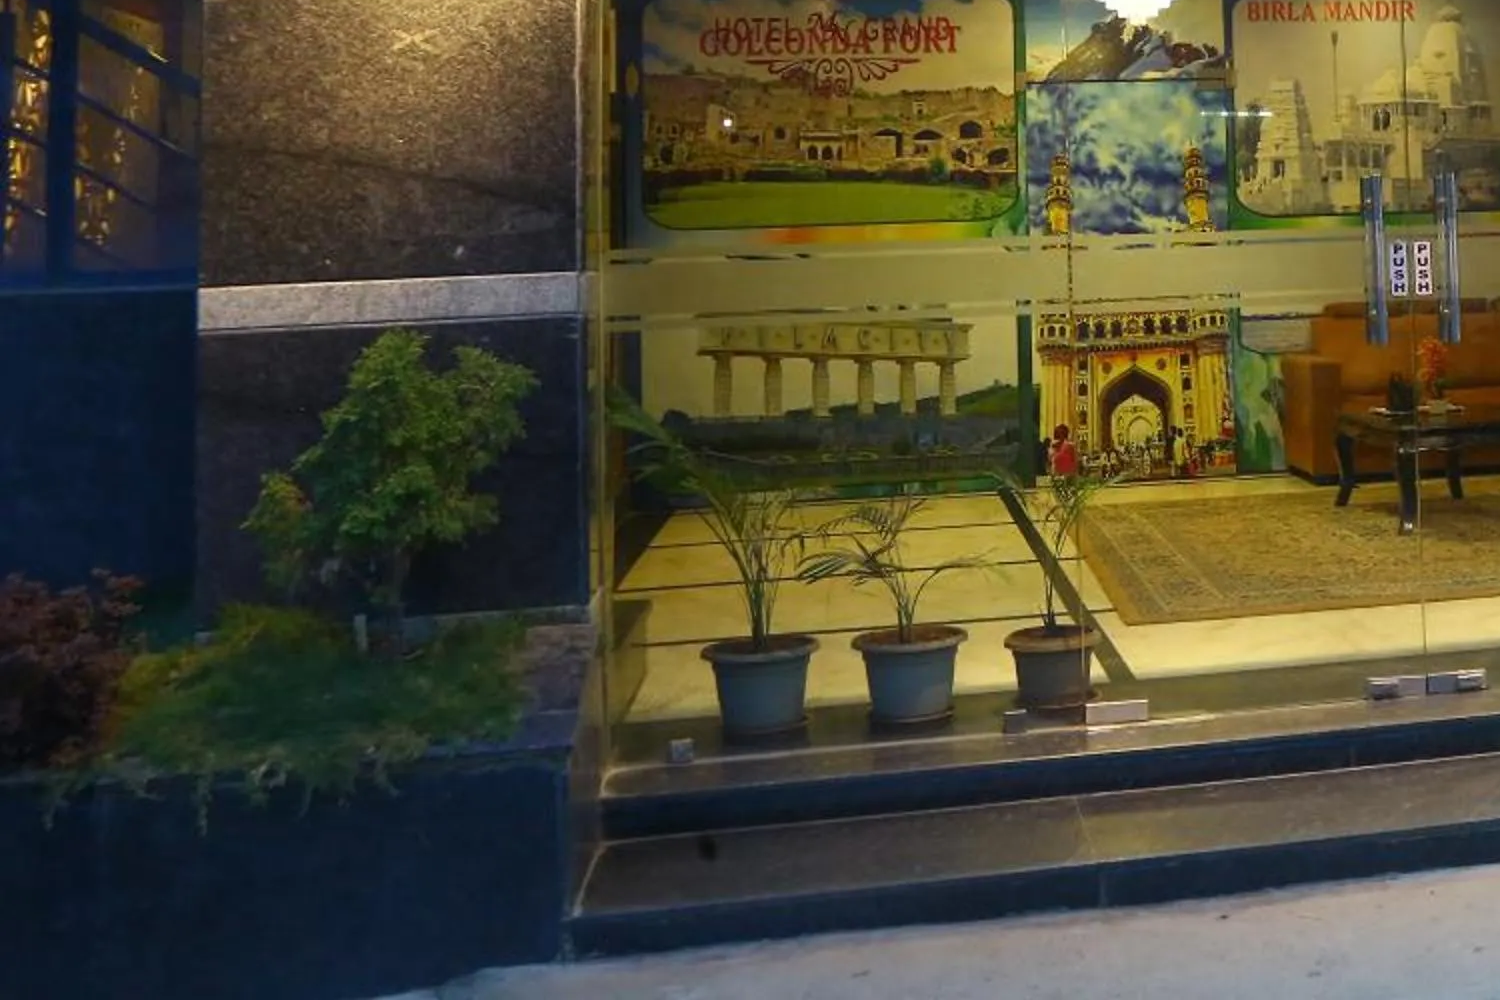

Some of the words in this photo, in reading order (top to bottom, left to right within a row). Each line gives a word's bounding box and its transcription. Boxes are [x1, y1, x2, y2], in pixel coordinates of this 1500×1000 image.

[1247, 0, 1317, 23] BIRLA
[1324, 0, 1416, 21] MANDIR
[1393, 243, 1406, 294] PUSH
[1416, 243, 1430, 293] PUSH
